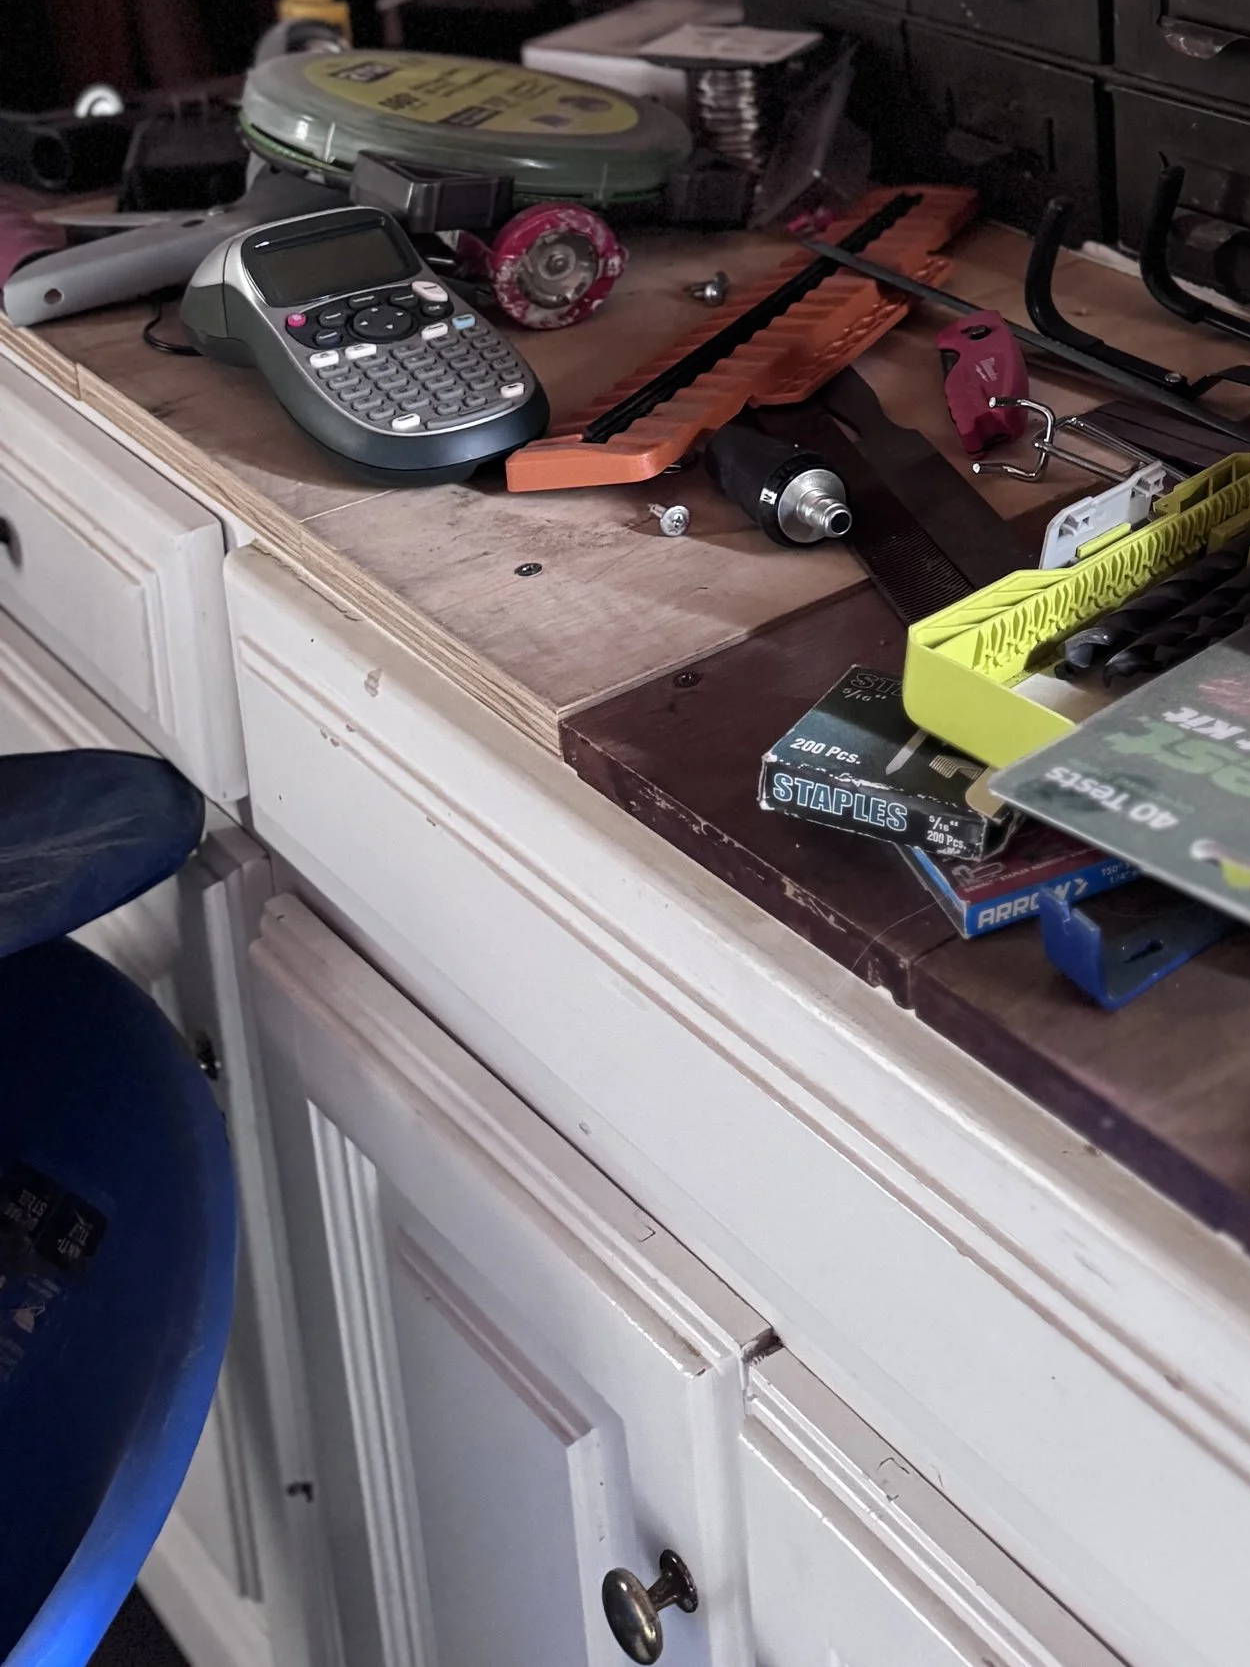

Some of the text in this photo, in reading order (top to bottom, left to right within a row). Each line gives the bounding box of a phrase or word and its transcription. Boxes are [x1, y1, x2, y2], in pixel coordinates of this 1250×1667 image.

[1162, 707, 1246, 740] Kit
[790, 738, 861, 764] 200 Pcs.
[773, 773, 908, 832] STAPLES
[1044, 766, 1126, 812] Tests
[1129, 802, 1180, 830] 40
[926, 830, 945, 845] 200
